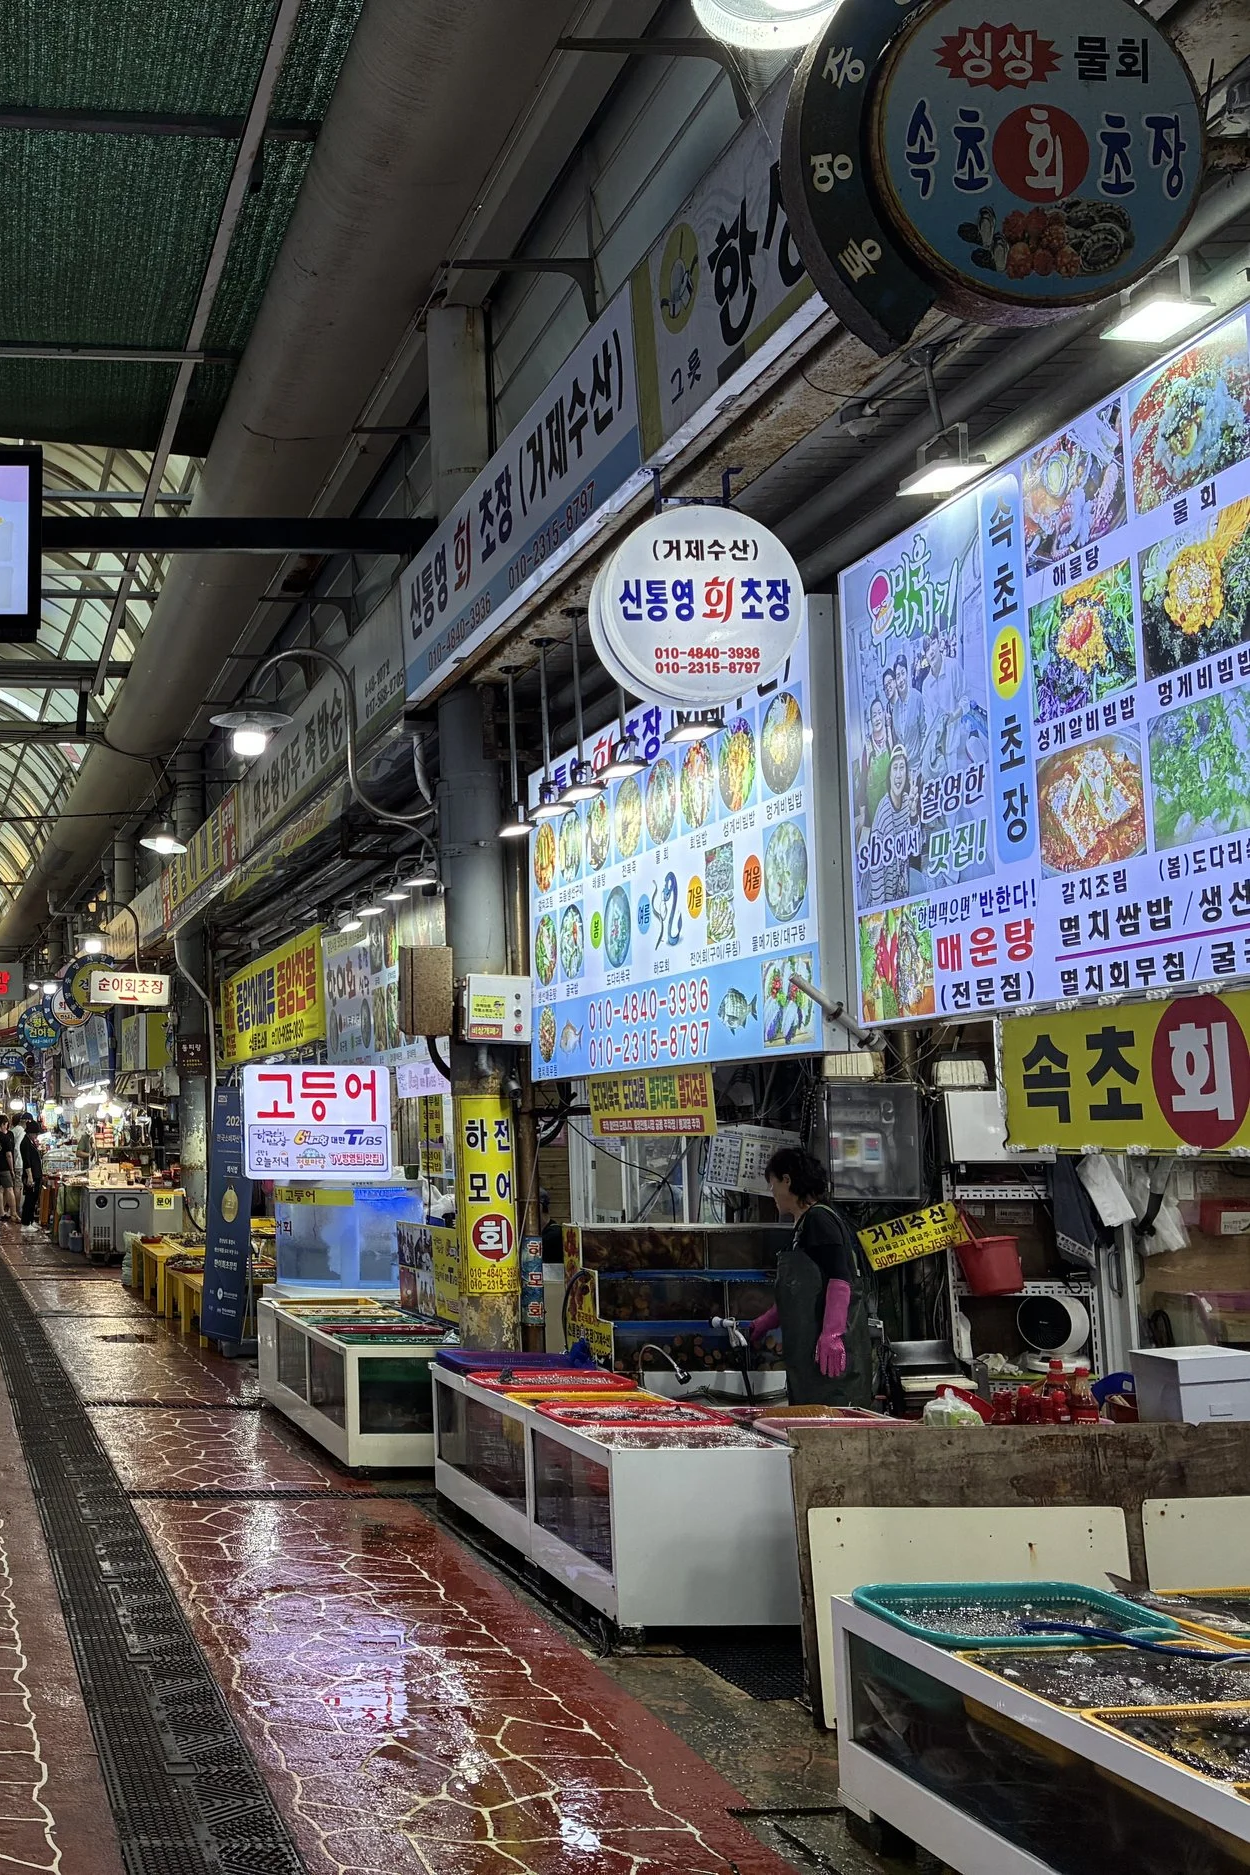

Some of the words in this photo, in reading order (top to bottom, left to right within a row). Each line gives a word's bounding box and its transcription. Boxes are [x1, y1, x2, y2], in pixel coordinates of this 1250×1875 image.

[957, 31, 1035, 82] 싱싱
[1073, 35, 1149, 84] 물회
[409, 543, 448, 642] 신통영
[453, 508, 472, 592] 회
[480, 463, 512, 565] 초장
[519, 328, 623, 516] (거제수산)
[508, 480, 596, 592] 010-2315-8797
[653, 539, 760, 562] (거제수산)
[1052, 547, 1101, 586] 해물탕
[654, 646, 760, 660] 010-4840-3936
[654, 661, 760, 675] 010-2315-8797
[1037, 695, 1136, 751] 성게알비빔밥
[765, 793, 803, 820] 멍게비빔밥
[920, 763, 987, 824] 촬영한
[927, 819, 988, 877] 맛집!
[743, 865, 761, 891] 겨울
[979, 877, 1037, 918] 반한다!
[1061, 868, 1128, 905] 갈치조림
[936, 917, 1035, 973] 매운탕
[1058, 895, 1174, 949] 멸치쌈밥
[97, 977, 164, 995] 순이회초장
[277, 942, 317, 1020] 중앙전복
[939, 969, 1036, 1012] (전문점)
[1060, 946, 1186, 997] 멸치회무침
[588, 977, 710, 1033] 010-4840-3936
[588, 1020, 711, 1069] 010-2315-8797
[256, 1070, 377, 1122] 고등어
[225, 1116, 240, 1126] 202
[478, 1219, 509, 1254] 회
[867, 1205, 949, 1245] 거제수산
